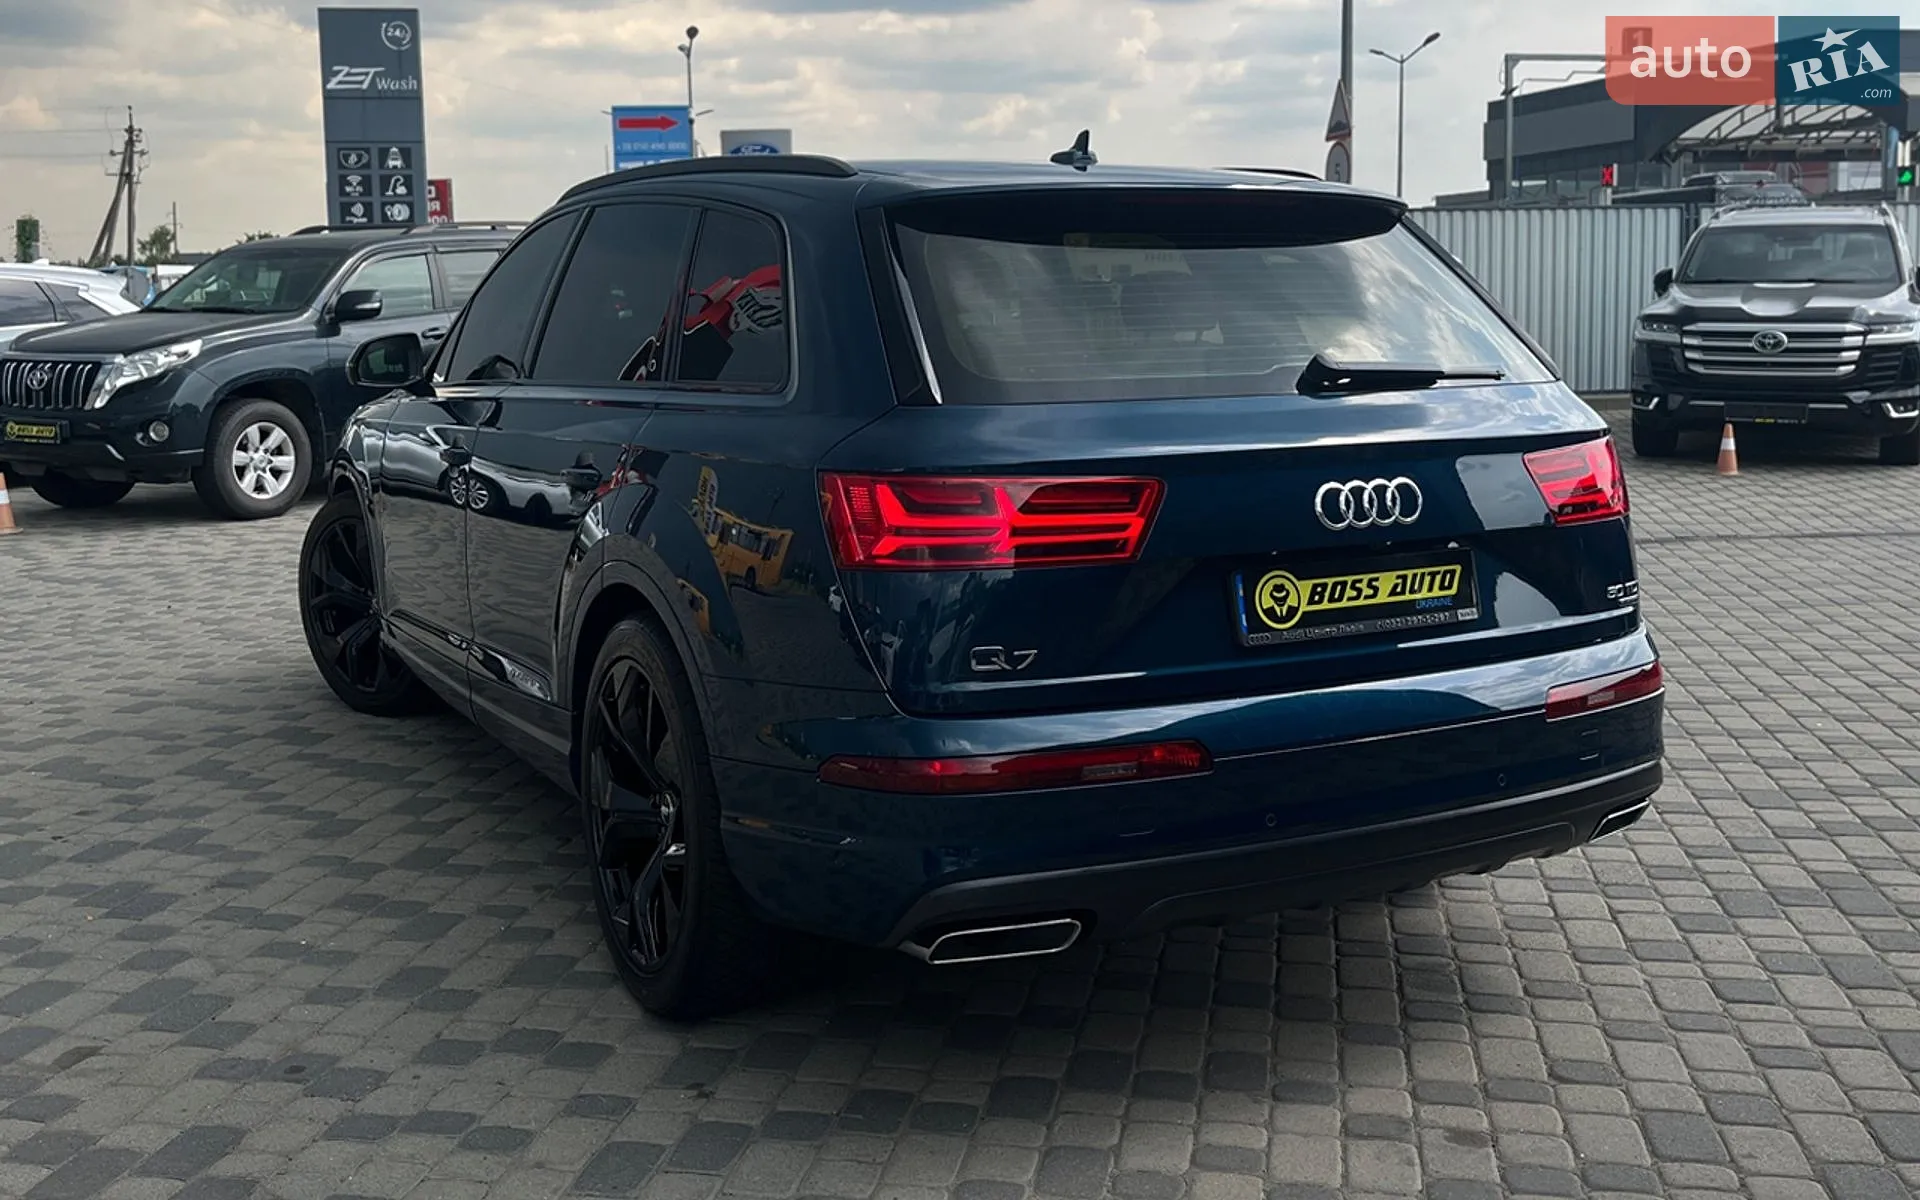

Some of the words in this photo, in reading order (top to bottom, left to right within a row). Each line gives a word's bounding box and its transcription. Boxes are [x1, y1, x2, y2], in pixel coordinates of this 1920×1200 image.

[326, 65, 385, 90] ZET
[377, 76, 418, 91] Wash
[1306, 574, 1381, 606] BOSS
[1387, 569, 1457, 598] AUTO
[1415, 597, 1454, 609] UKRAINE
[970, 645, 1038, 671] Q7
